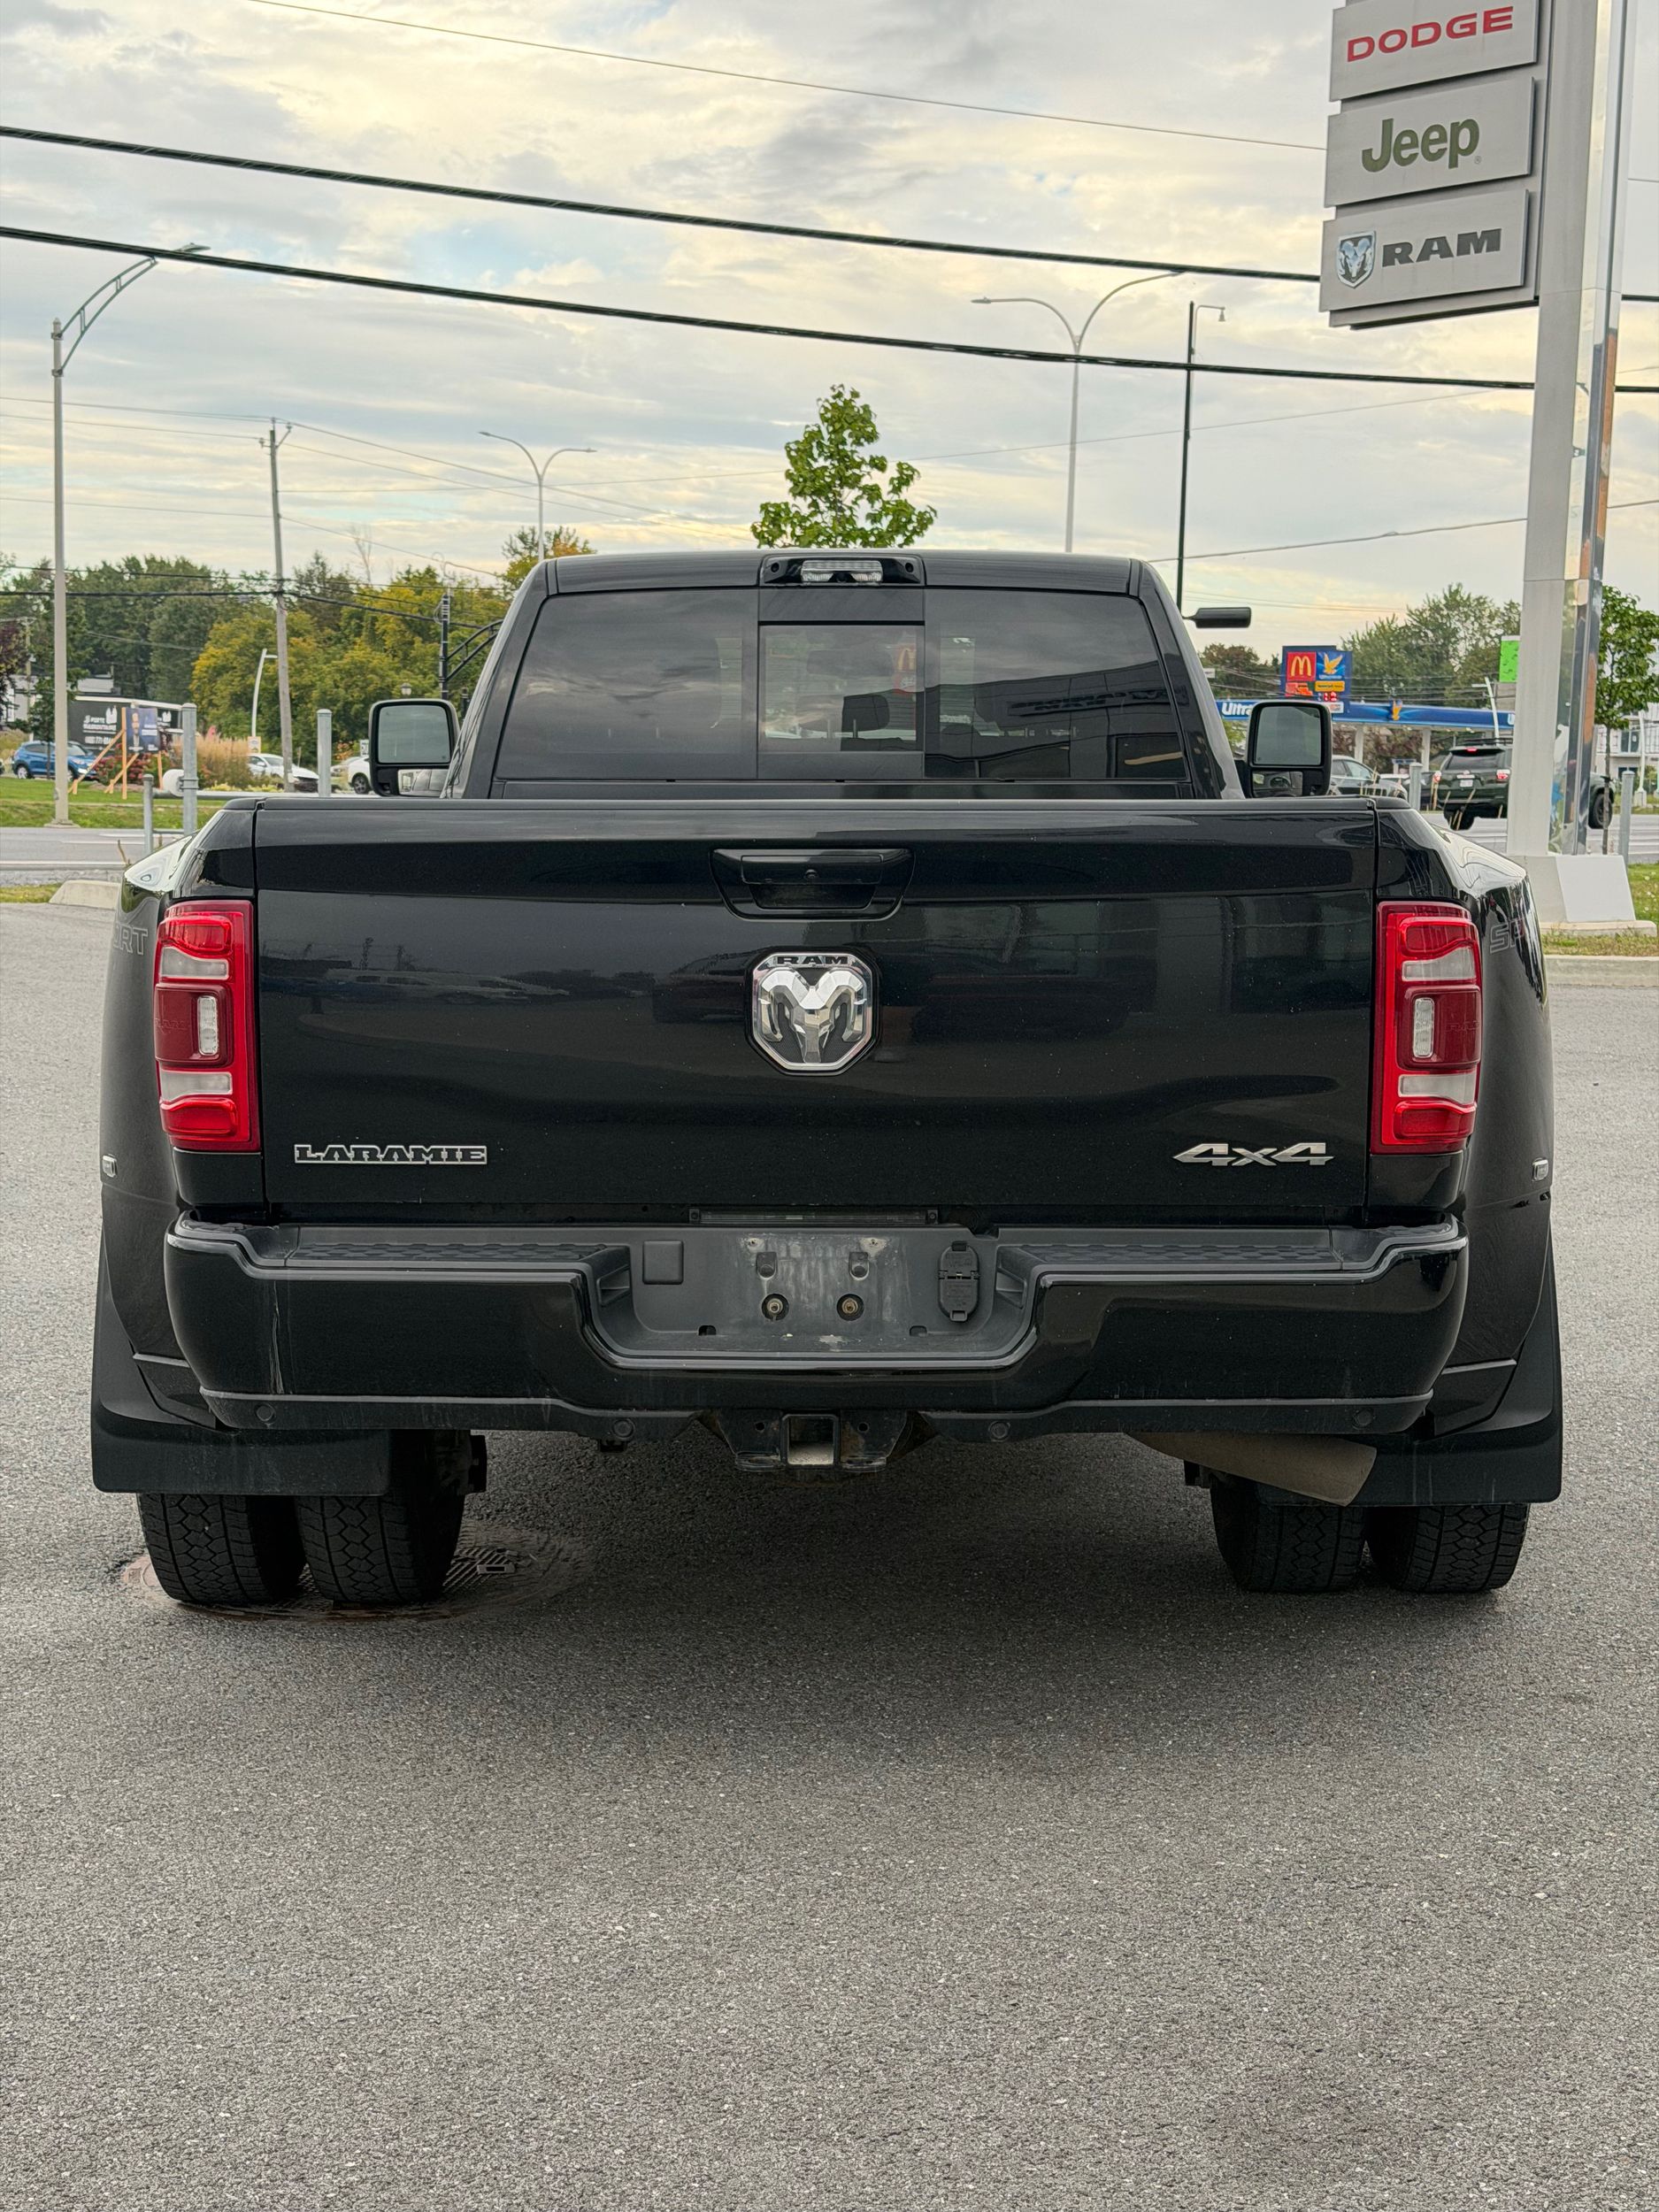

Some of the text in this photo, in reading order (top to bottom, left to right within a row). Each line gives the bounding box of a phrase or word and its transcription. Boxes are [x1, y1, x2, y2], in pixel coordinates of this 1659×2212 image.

[1347, 6, 1514, 63] DODGE
[1361, 118, 1480, 173] Jeep
[1381, 227, 1502, 268] RAM
[777, 955, 849, 965] RAM
[294, 1144, 487, 1164] LARAMIE
[1172, 1141, 1334, 1166] 4x4
